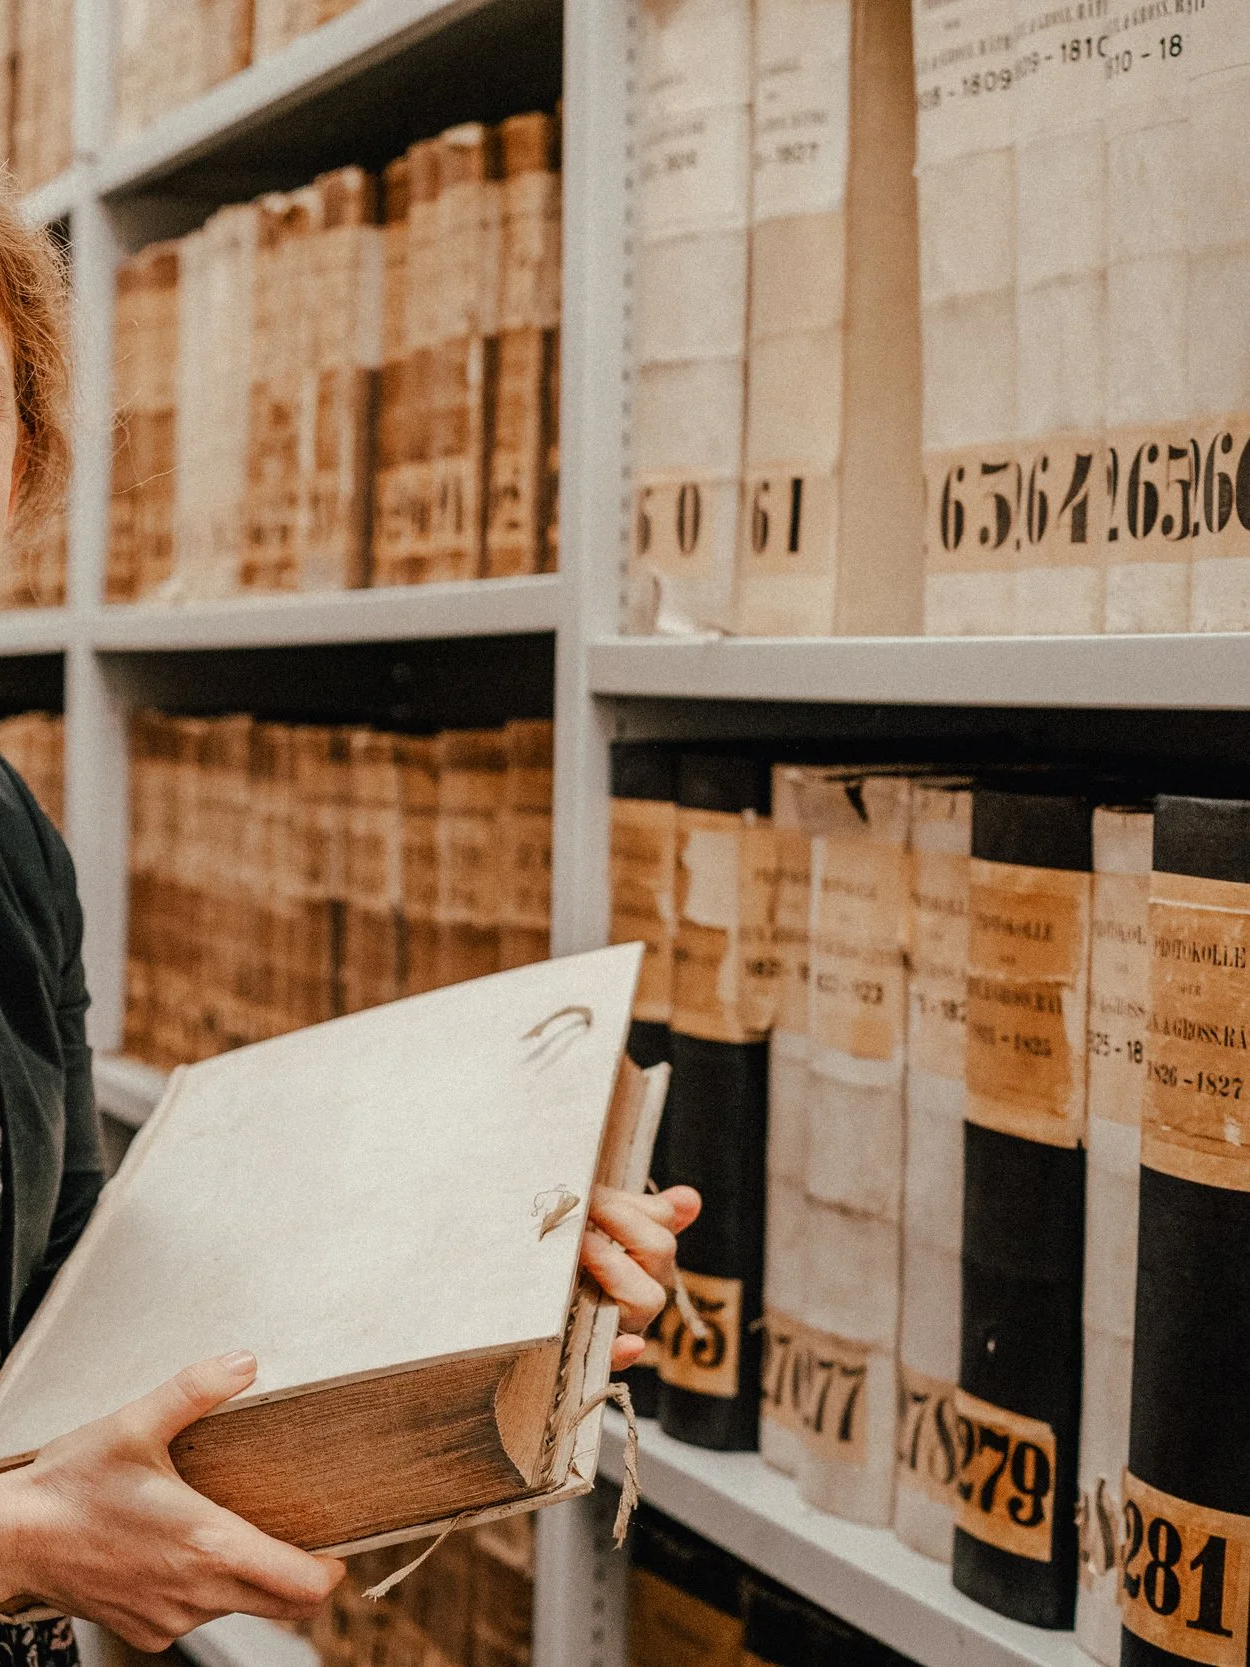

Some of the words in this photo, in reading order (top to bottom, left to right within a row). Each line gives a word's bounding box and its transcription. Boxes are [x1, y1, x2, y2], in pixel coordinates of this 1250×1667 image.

[1014, 453, 1094, 552] 64
[1196, 1070, 1245, 1101] 1827
[956, 1413, 1052, 1528] 279
[1123, 1499, 1234, 1639] 281
